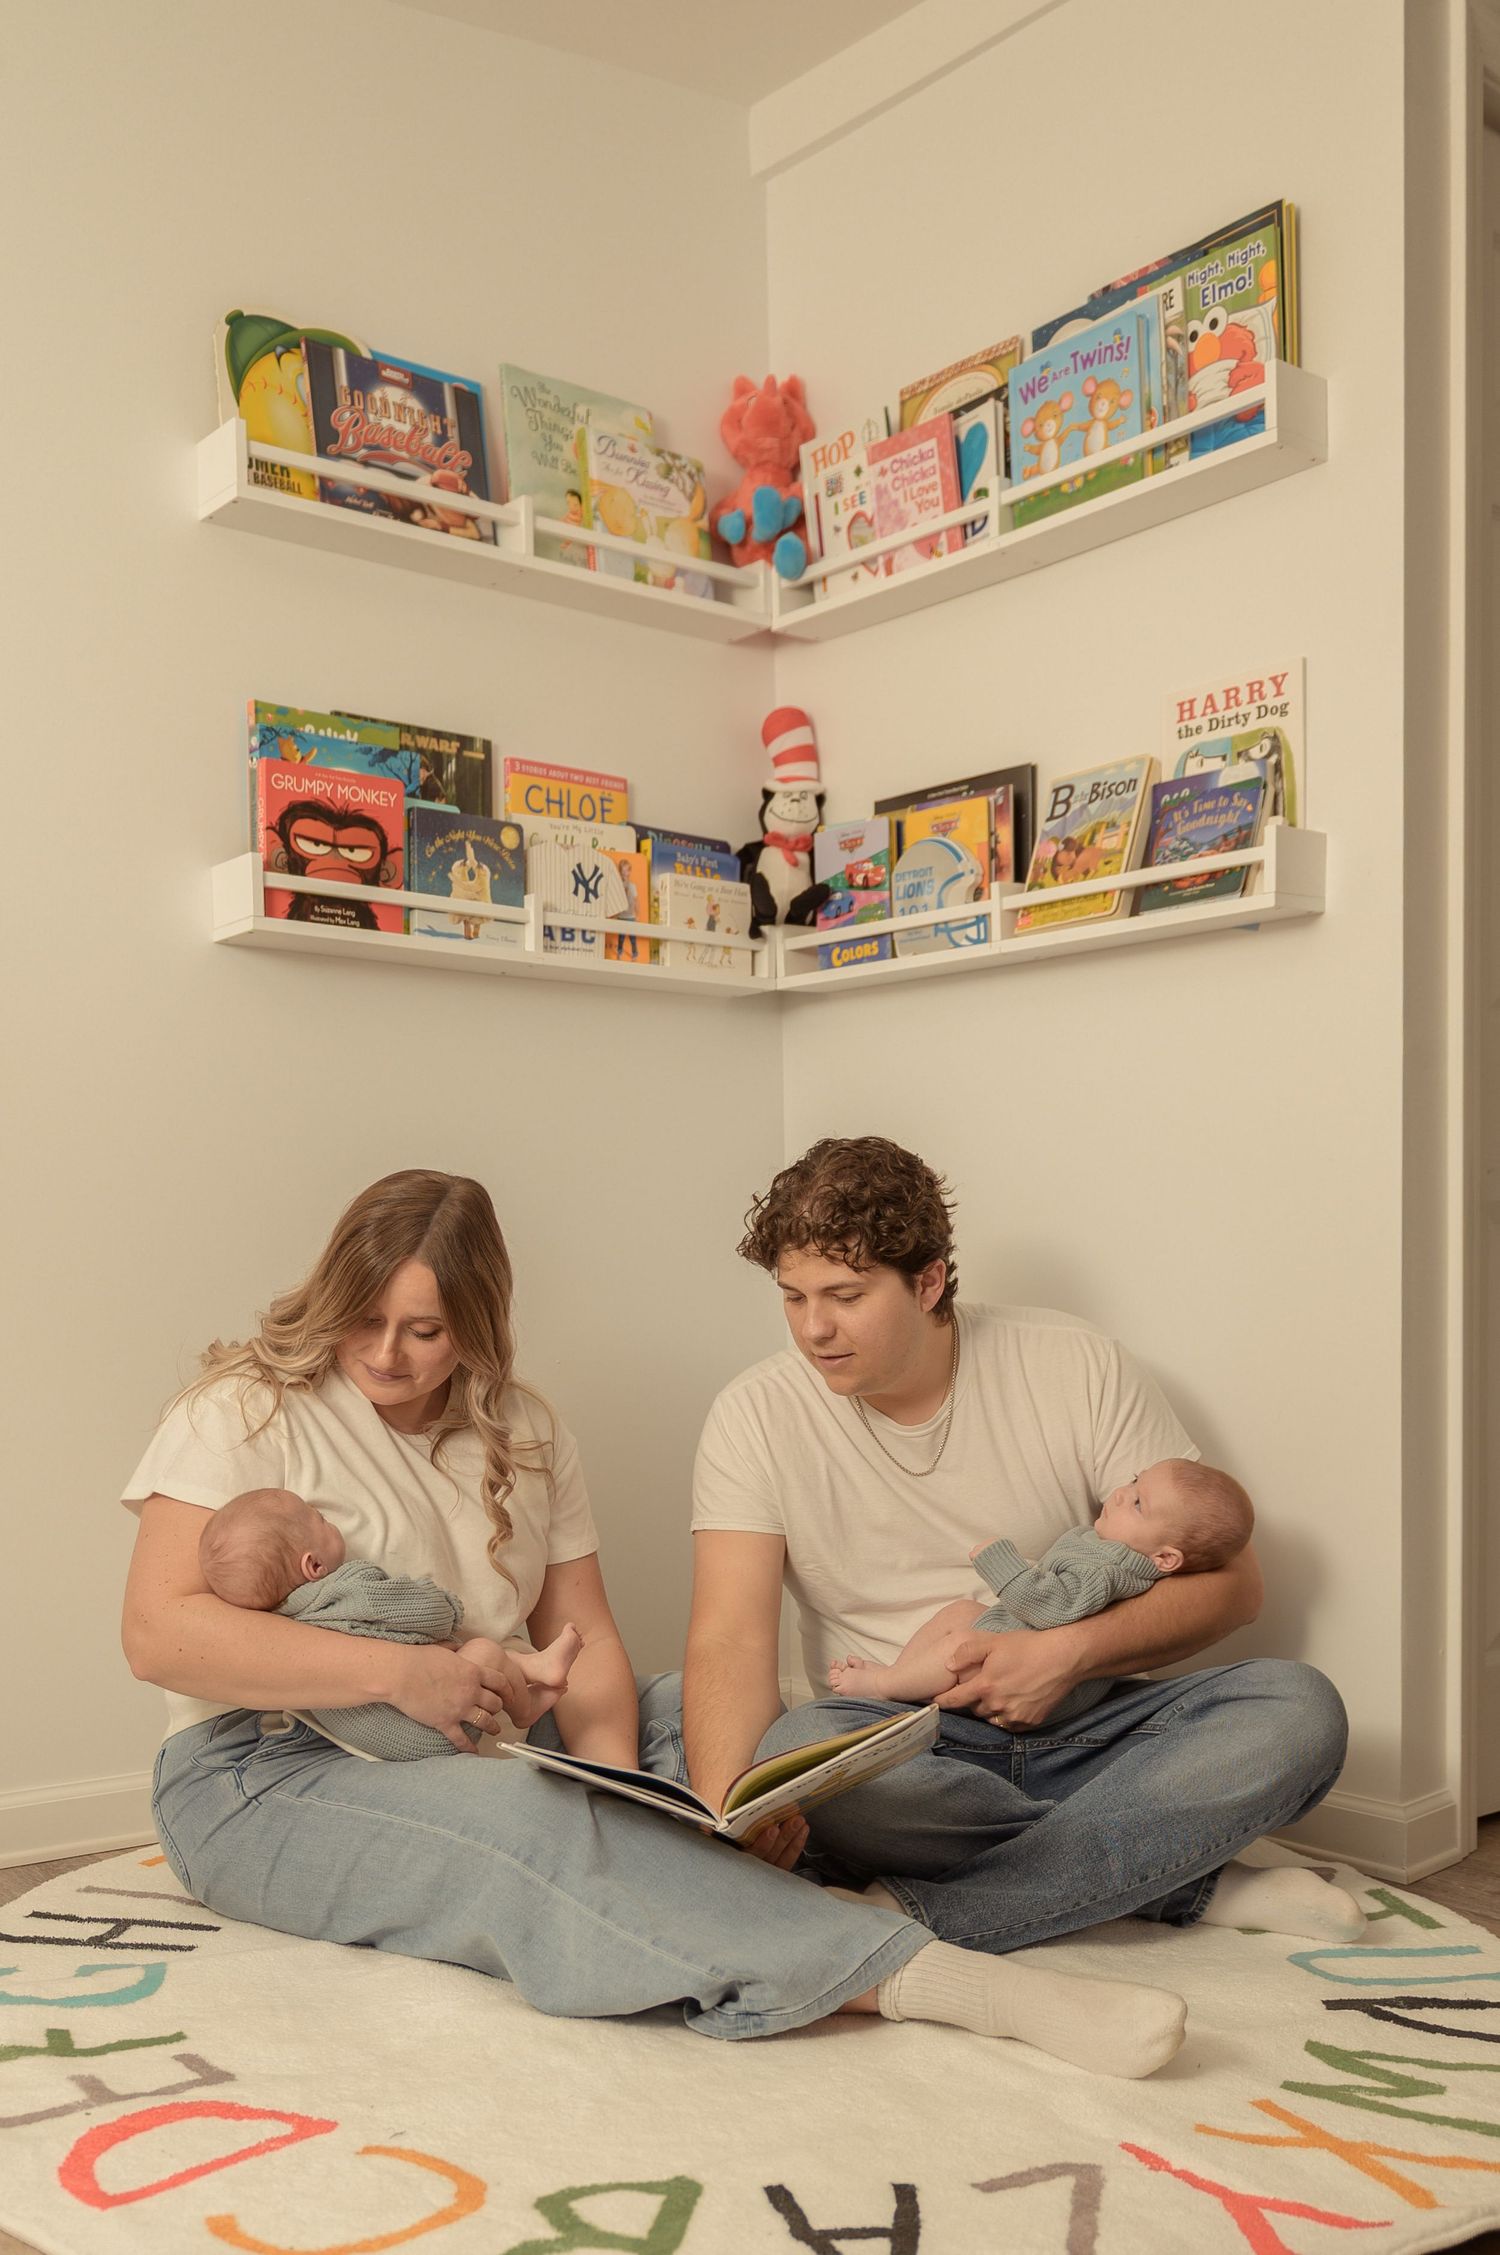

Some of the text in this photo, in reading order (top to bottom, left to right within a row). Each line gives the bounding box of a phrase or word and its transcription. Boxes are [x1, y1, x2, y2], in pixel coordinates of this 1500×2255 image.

[1185, 240, 1266, 288] Night, Night,
[1200, 266, 1253, 309] Elmo!
[1018, 374, 1050, 406] We
[1070, 335, 1132, 375] Twins!
[340, 384, 456, 440] GOODNIGHT
[326, 404, 473, 471] Baseball
[810, 430, 856, 478] HOP
[890, 448, 936, 473] Chicka
[891, 464, 937, 491] Chicka
[253, 471, 303, 495] BASEBALL
[842, 490, 867, 512] SEE
[910, 480, 939, 500] Love
[915, 496, 940, 514] You
[1176, 672, 1289, 724] HARRY
[1176, 701, 1291, 740] the Dirty Dog
[271, 773, 398, 808] GRUMPY MONKEY
[1045, 784, 1075, 822] B
[1088, 777, 1138, 804] Bison
[571, 862, 604, 904] NY
[895, 865, 934, 882] DETROIT
[895, 878, 936, 900] LIONS
[831, 940, 879, 968] COLORS
[57, 2100, 339, 2212] D
